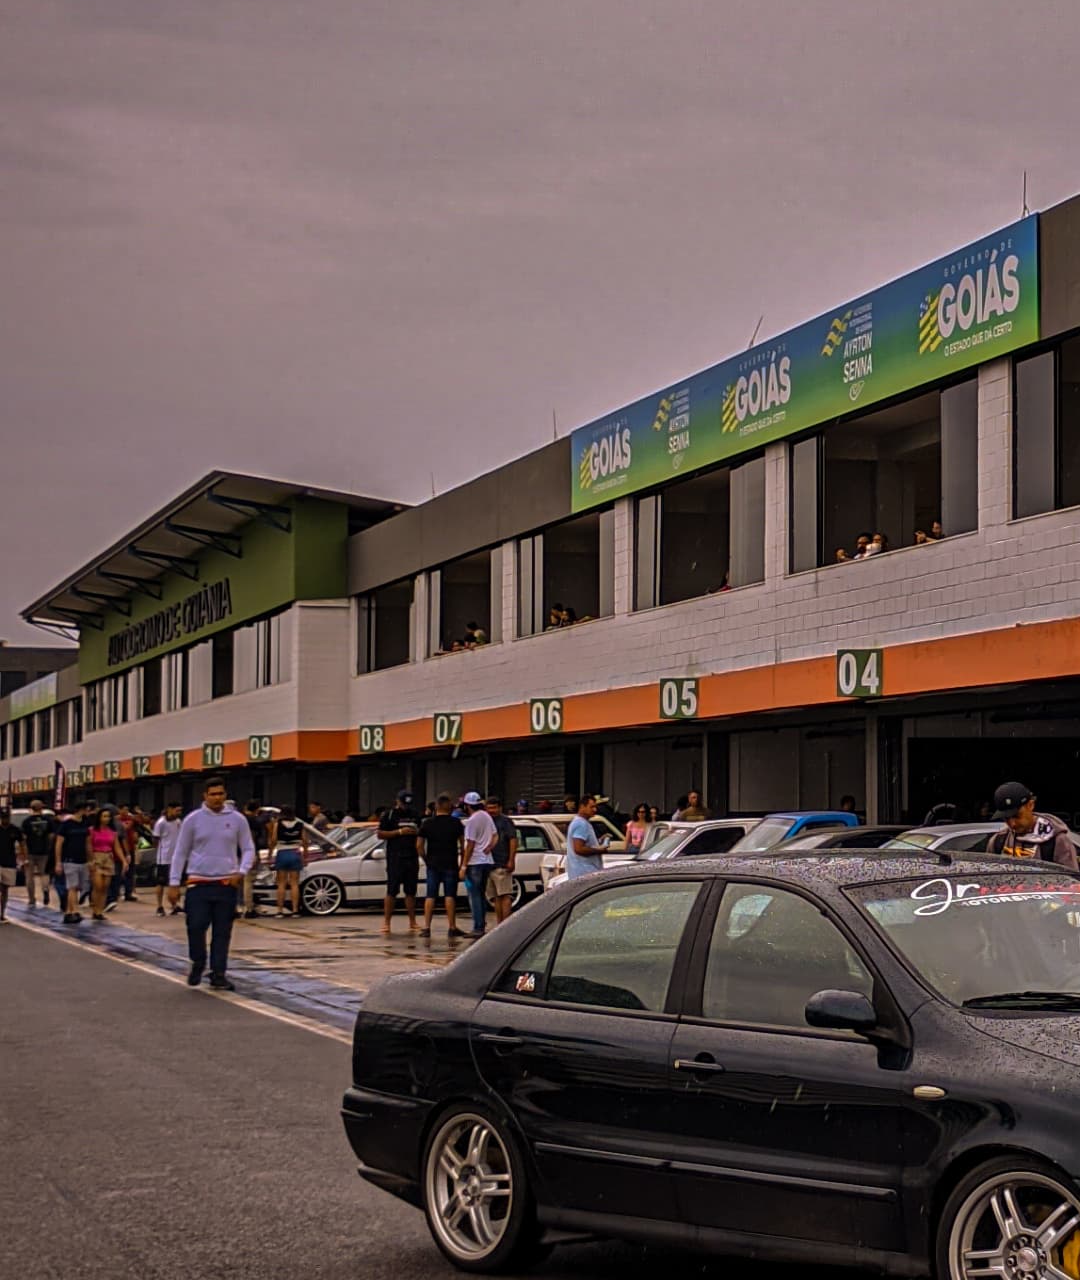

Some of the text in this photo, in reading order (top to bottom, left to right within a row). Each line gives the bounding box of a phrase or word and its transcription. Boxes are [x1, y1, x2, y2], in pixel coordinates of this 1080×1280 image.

[937, 249, 1020, 338] GOIÁS
[843, 353, 873, 383] SENNA
[734, 349, 791, 421] GOIÁS
[590, 422, 632, 480] GOIÁS
[838, 651, 880, 695] 04
[661, 680, 697, 717] 05
[435, 715, 461, 742] 07
[531, 700, 561, 732] 06
[250, 736, 271, 759] 09
[361, 727, 383, 751] 08
[135, 757, 149, 776] 12
[167, 751, 181, 770] 11
[204, 745, 223, 766] 10
[82, 766, 94, 782] 14
[105, 762, 120, 779] 13
